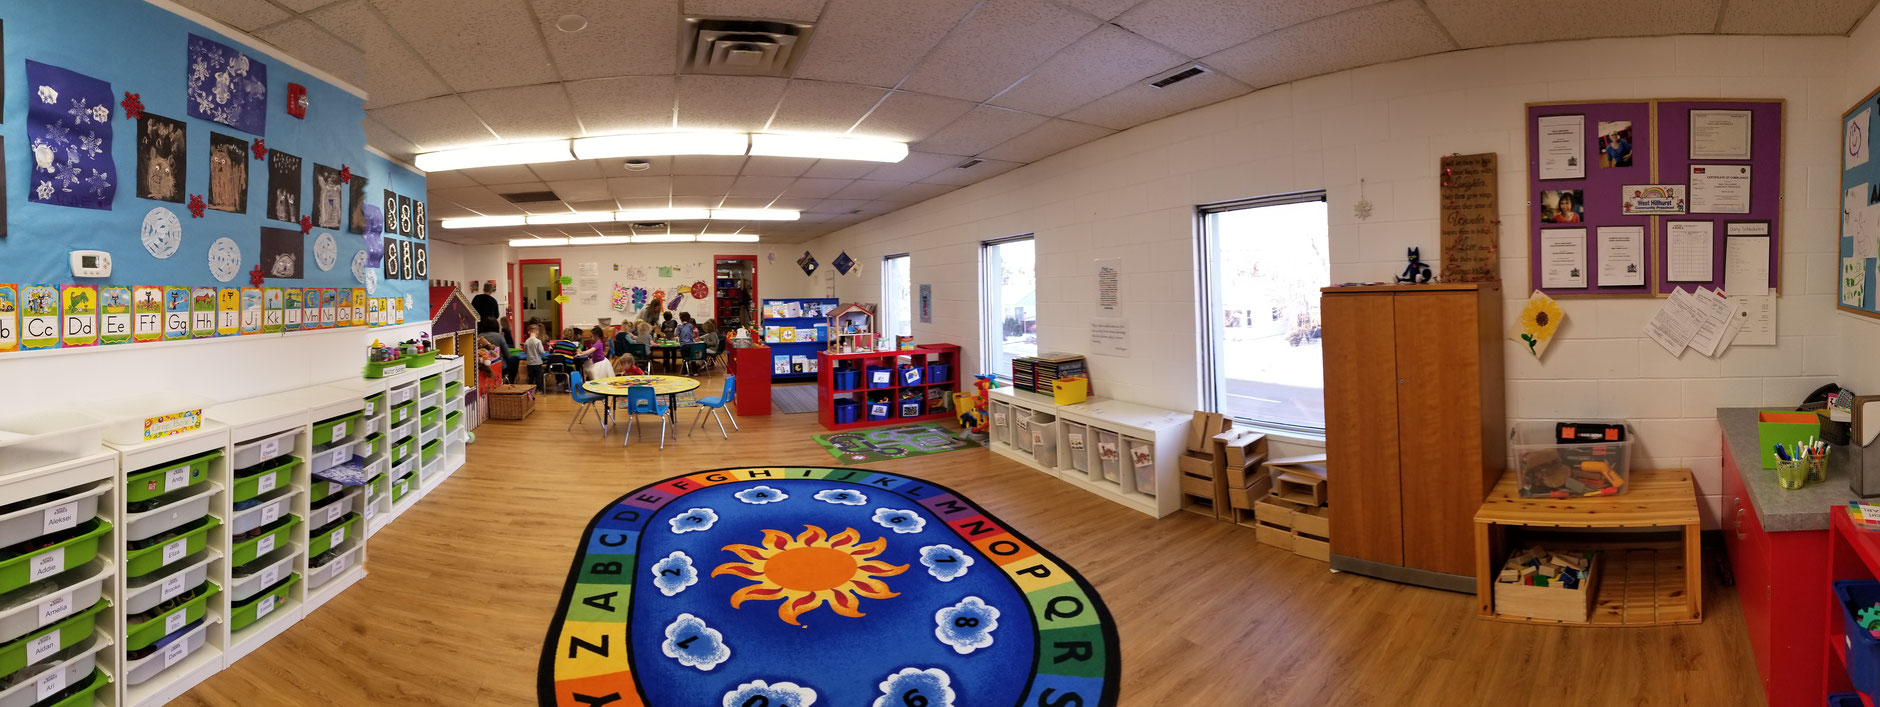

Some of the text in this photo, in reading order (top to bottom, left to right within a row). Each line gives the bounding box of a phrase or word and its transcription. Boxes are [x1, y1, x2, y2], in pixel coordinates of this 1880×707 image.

[28, 318, 53, 337] Cc
[68, 316, 92, 335] Dd
[108, 316, 125, 333] Ee
[140, 314, 156, 331] Ff
[168, 314, 187, 336] Gg
[196, 313, 212, 329] Hh
[226, 312, 233, 327] Ii
[245, 312, 258, 330] Jj
[267, 311, 279, 324] Kk
[322, 310, 334, 321] Nn
[339, 308, 350, 320] Oo
[354, 308, 363, 322] Pp
[152, 422, 171, 432] Drop
[172, 476, 183, 484] Andy
[705, 473, 728, 482] G
[748, 470, 772, 478] H
[837, 471, 857, 480] J
[672, 481, 691, 490] F
[872, 477, 897, 487] K
[906, 486, 924, 496] L
[636, 494, 662, 504] E
[934, 499, 968, 514] M
[48, 514, 72, 526] Aleksei
[613, 510, 640, 522] D
[890, 516, 907, 524] 6
[960, 520, 995, 536] N
[600, 534, 628, 547] C
[168, 550, 180, 558] Eliza
[988, 540, 1020, 556] O
[36, 564, 56, 576] Addie
[590, 560, 622, 575] B
[661, 568, 681, 577] 2
[1016, 564, 1052, 580] P
[164, 584, 180, 595] Brooke
[582, 591, 618, 612] A
[45, 604, 68, 618] Amelia
[1044, 596, 1084, 622] Q
[954, 616, 979, 628] 8
[35, 641, 54, 656] Aidan
[568, 634, 608, 658] Z
[677, 636, 699, 650] 1
[1053, 642, 1093, 664] R
[46, 683, 55, 692] Ari
